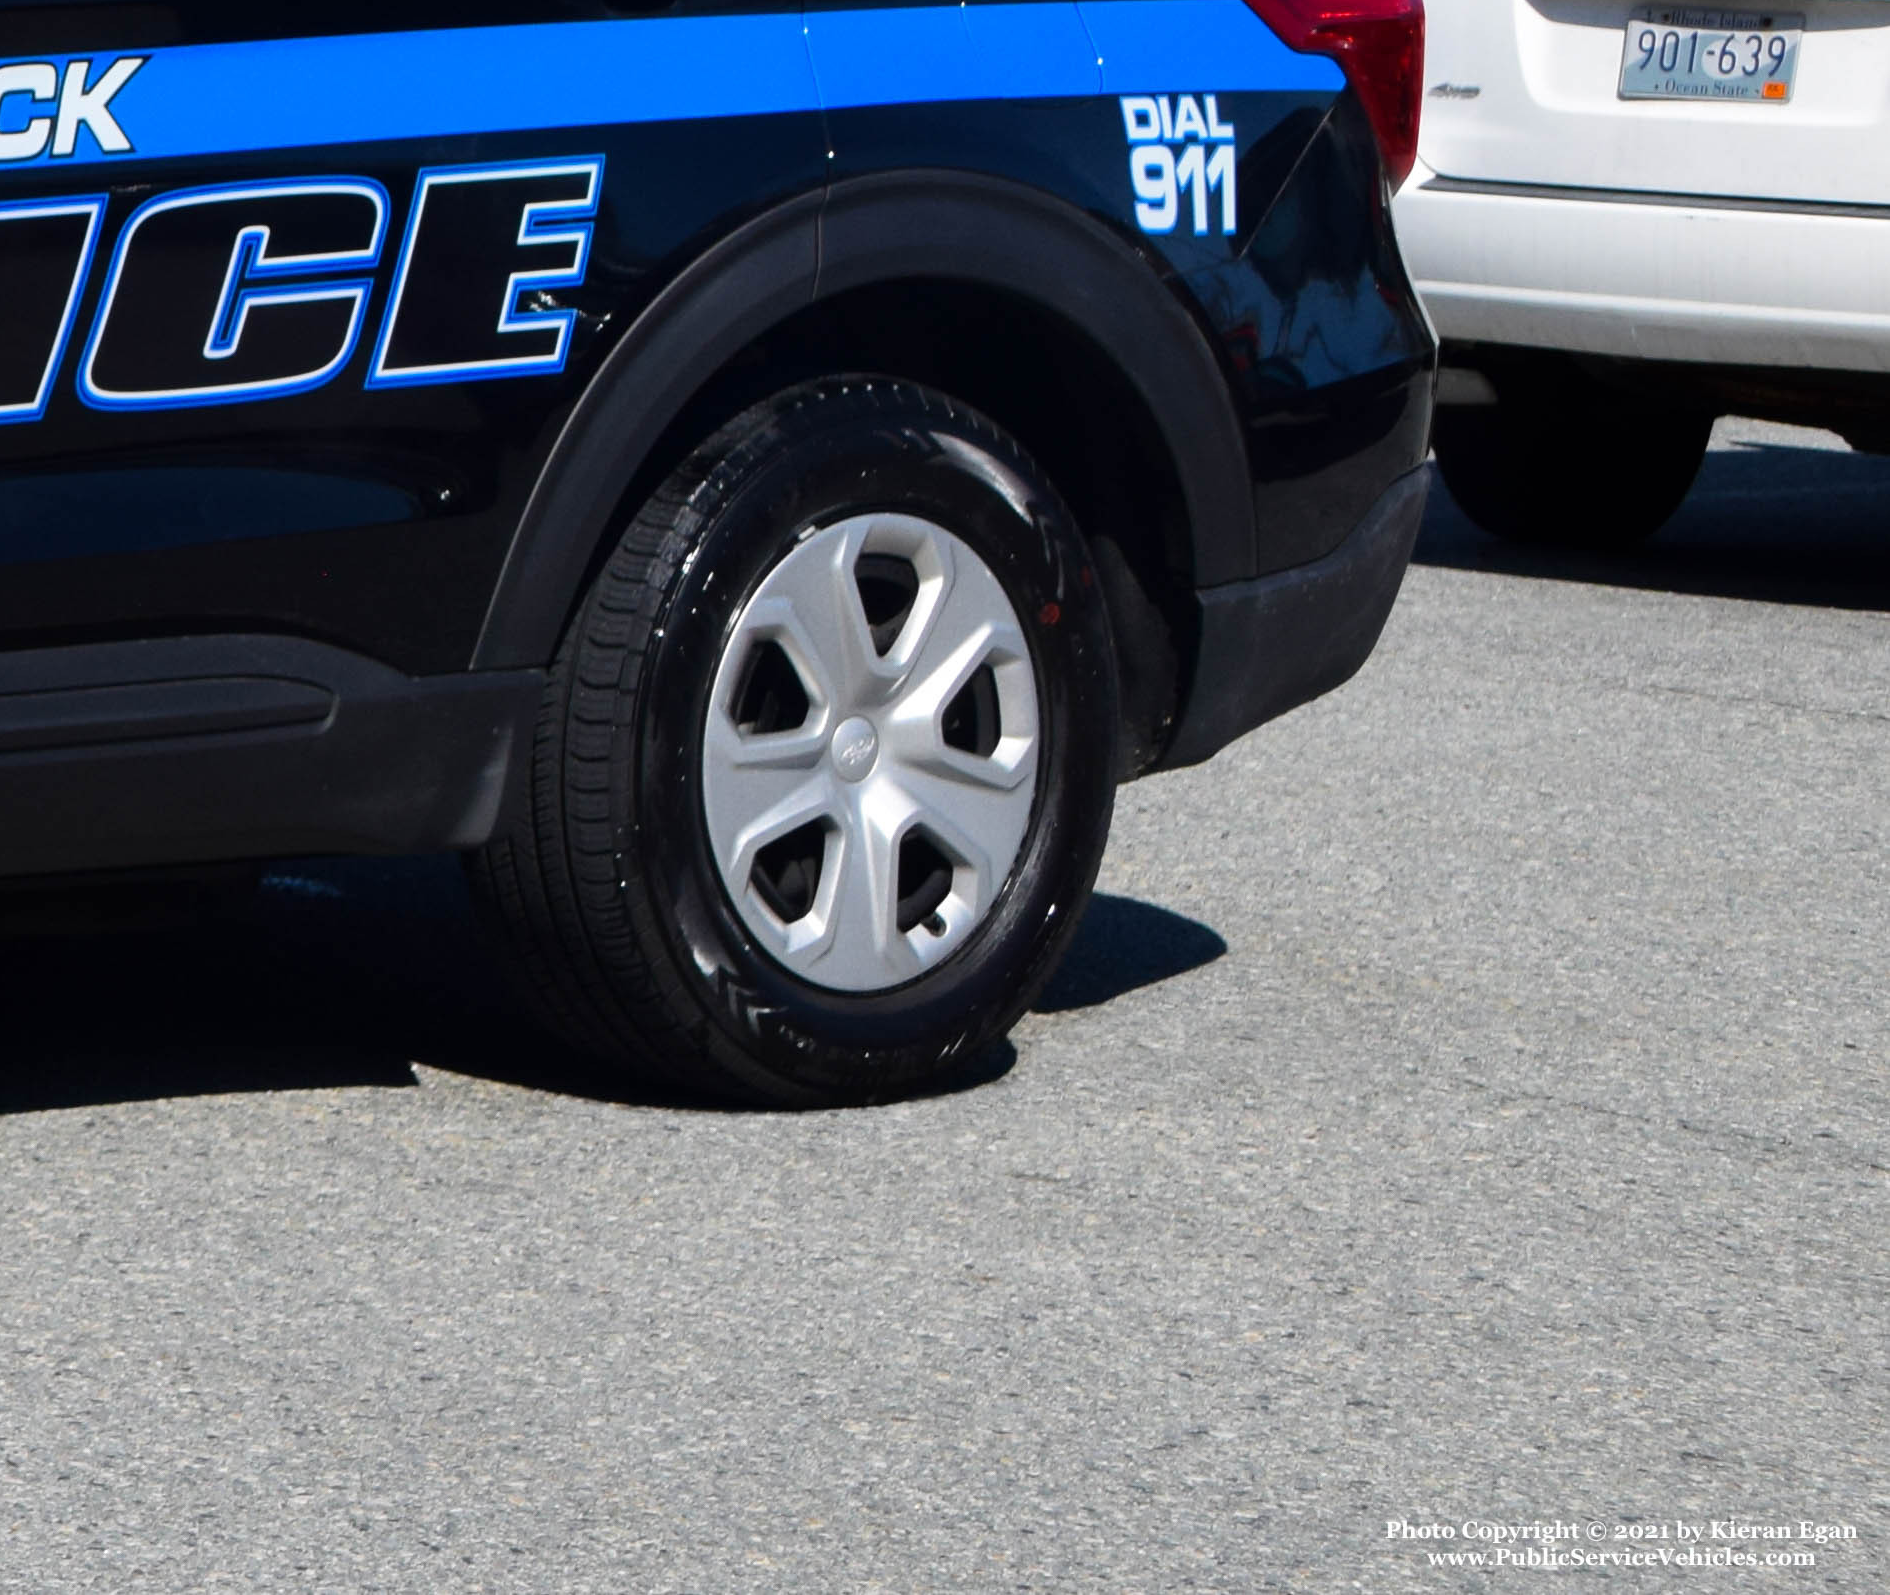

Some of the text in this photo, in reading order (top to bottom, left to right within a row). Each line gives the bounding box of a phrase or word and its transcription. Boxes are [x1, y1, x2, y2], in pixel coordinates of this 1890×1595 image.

[1638, 28, 1787, 78] 901-639
[1664, 78, 1708, 95] Ocean
[1714, 79, 1749, 97] State
[1121, 94, 1234, 142] DIAL
[1129, 144, 1236, 235] 911
